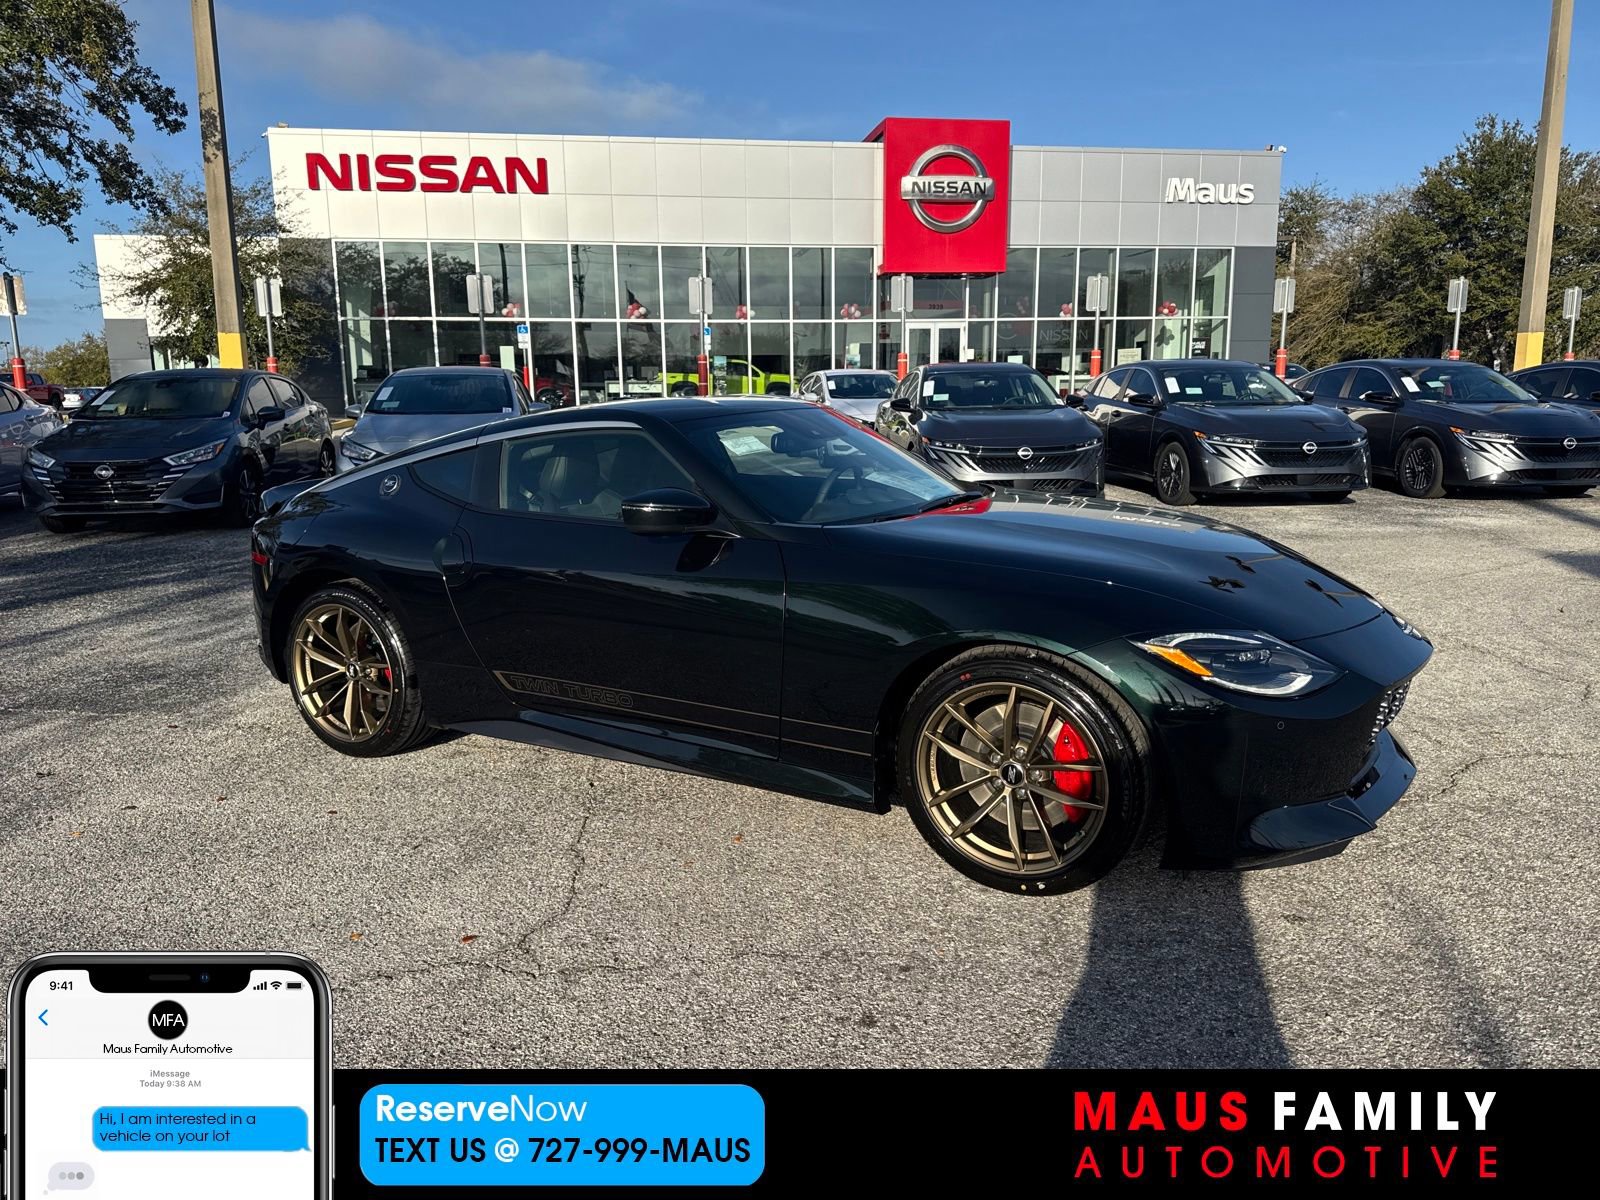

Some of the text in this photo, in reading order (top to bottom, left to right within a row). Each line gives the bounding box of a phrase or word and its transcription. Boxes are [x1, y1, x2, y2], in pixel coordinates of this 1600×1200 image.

[306, 153, 549, 194] NISSAN
[911, 181, 987, 194] NISSAN
[1165, 177, 1255, 205] Maus
[1039, 329, 1089, 341] NISSN
[511, 676, 634, 708] TWIN TURBO
